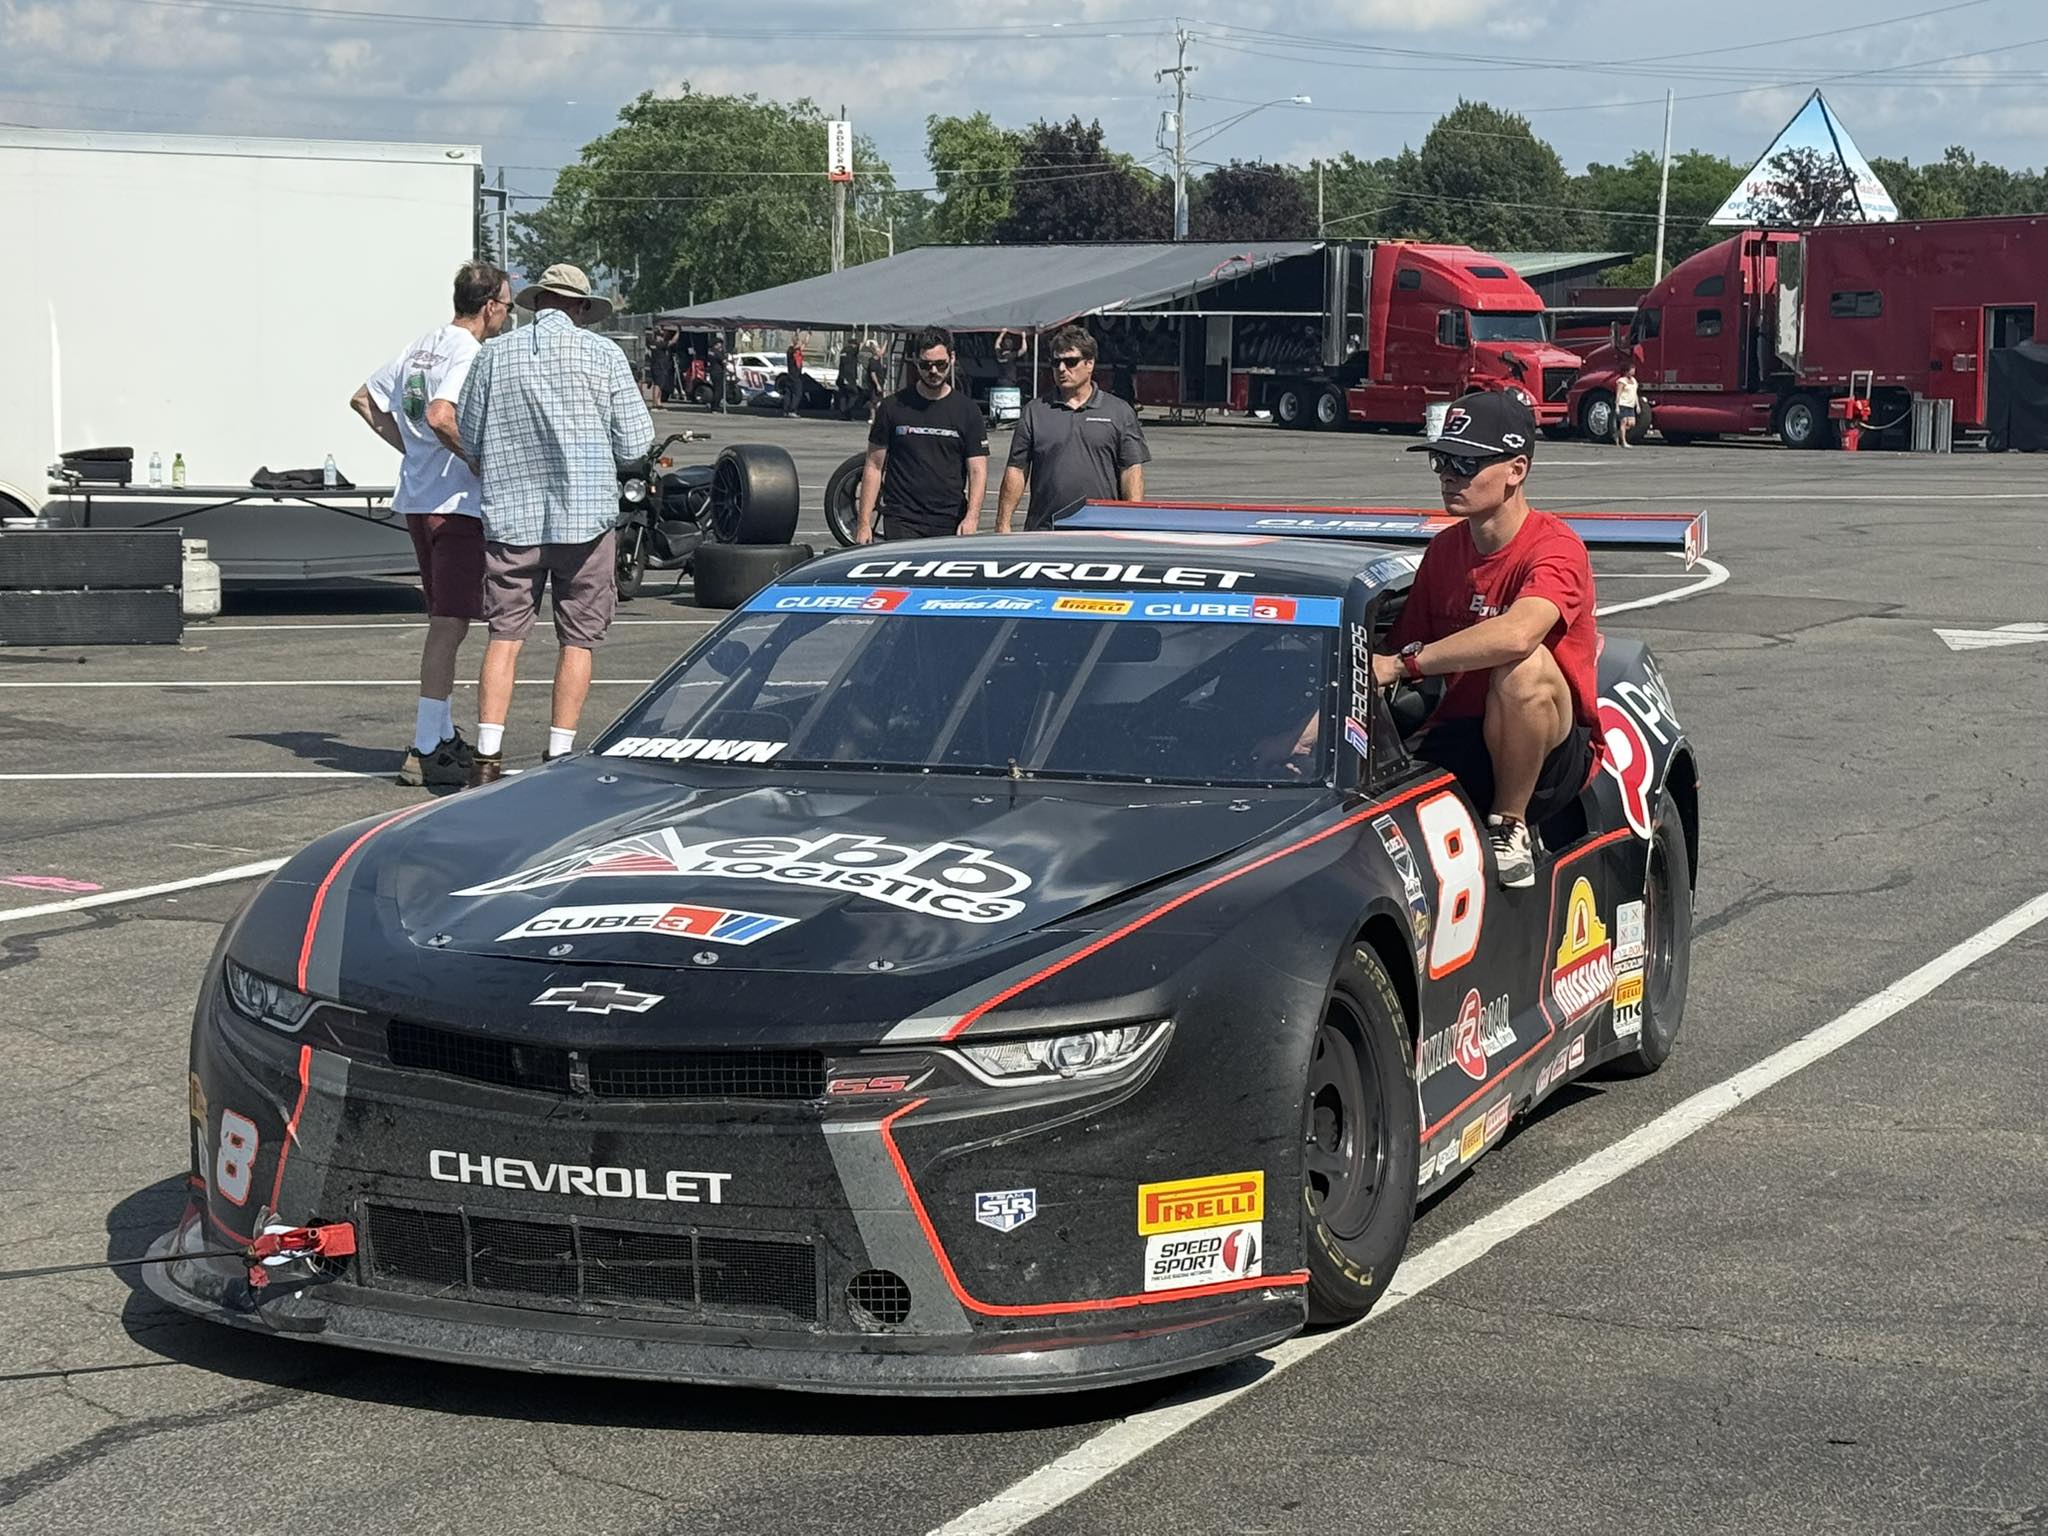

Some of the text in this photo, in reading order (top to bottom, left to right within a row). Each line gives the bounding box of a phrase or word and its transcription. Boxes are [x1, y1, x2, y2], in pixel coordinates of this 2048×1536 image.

[847, 561, 1255, 588] CHEVROLET
[776, 596, 888, 610] CUBE3
[921, 599, 1033, 610] Trans Am
[1059, 600, 1127, 613] PIRELLI
[1144, 602, 1278, 618] CUBE3
[601, 737, 789, 763] BROWN
[688, 860, 1012, 918] LOGISTICS
[1416, 790, 1485, 979] 8
[525, 914, 694, 932] CUBE3
[1555, 954, 1614, 1016] MISSION
[828, 1075, 911, 1096] SS
[217, 1108, 258, 1206] 8
[430, 1149, 732, 1203] CHEVROLET
[979, 1198, 1032, 1216] SLR
[1146, 1181, 1257, 1224] PIRELLI
[1160, 1237, 1222, 1258] SPEED
[1153, 1253, 1220, 1275] SPORT
